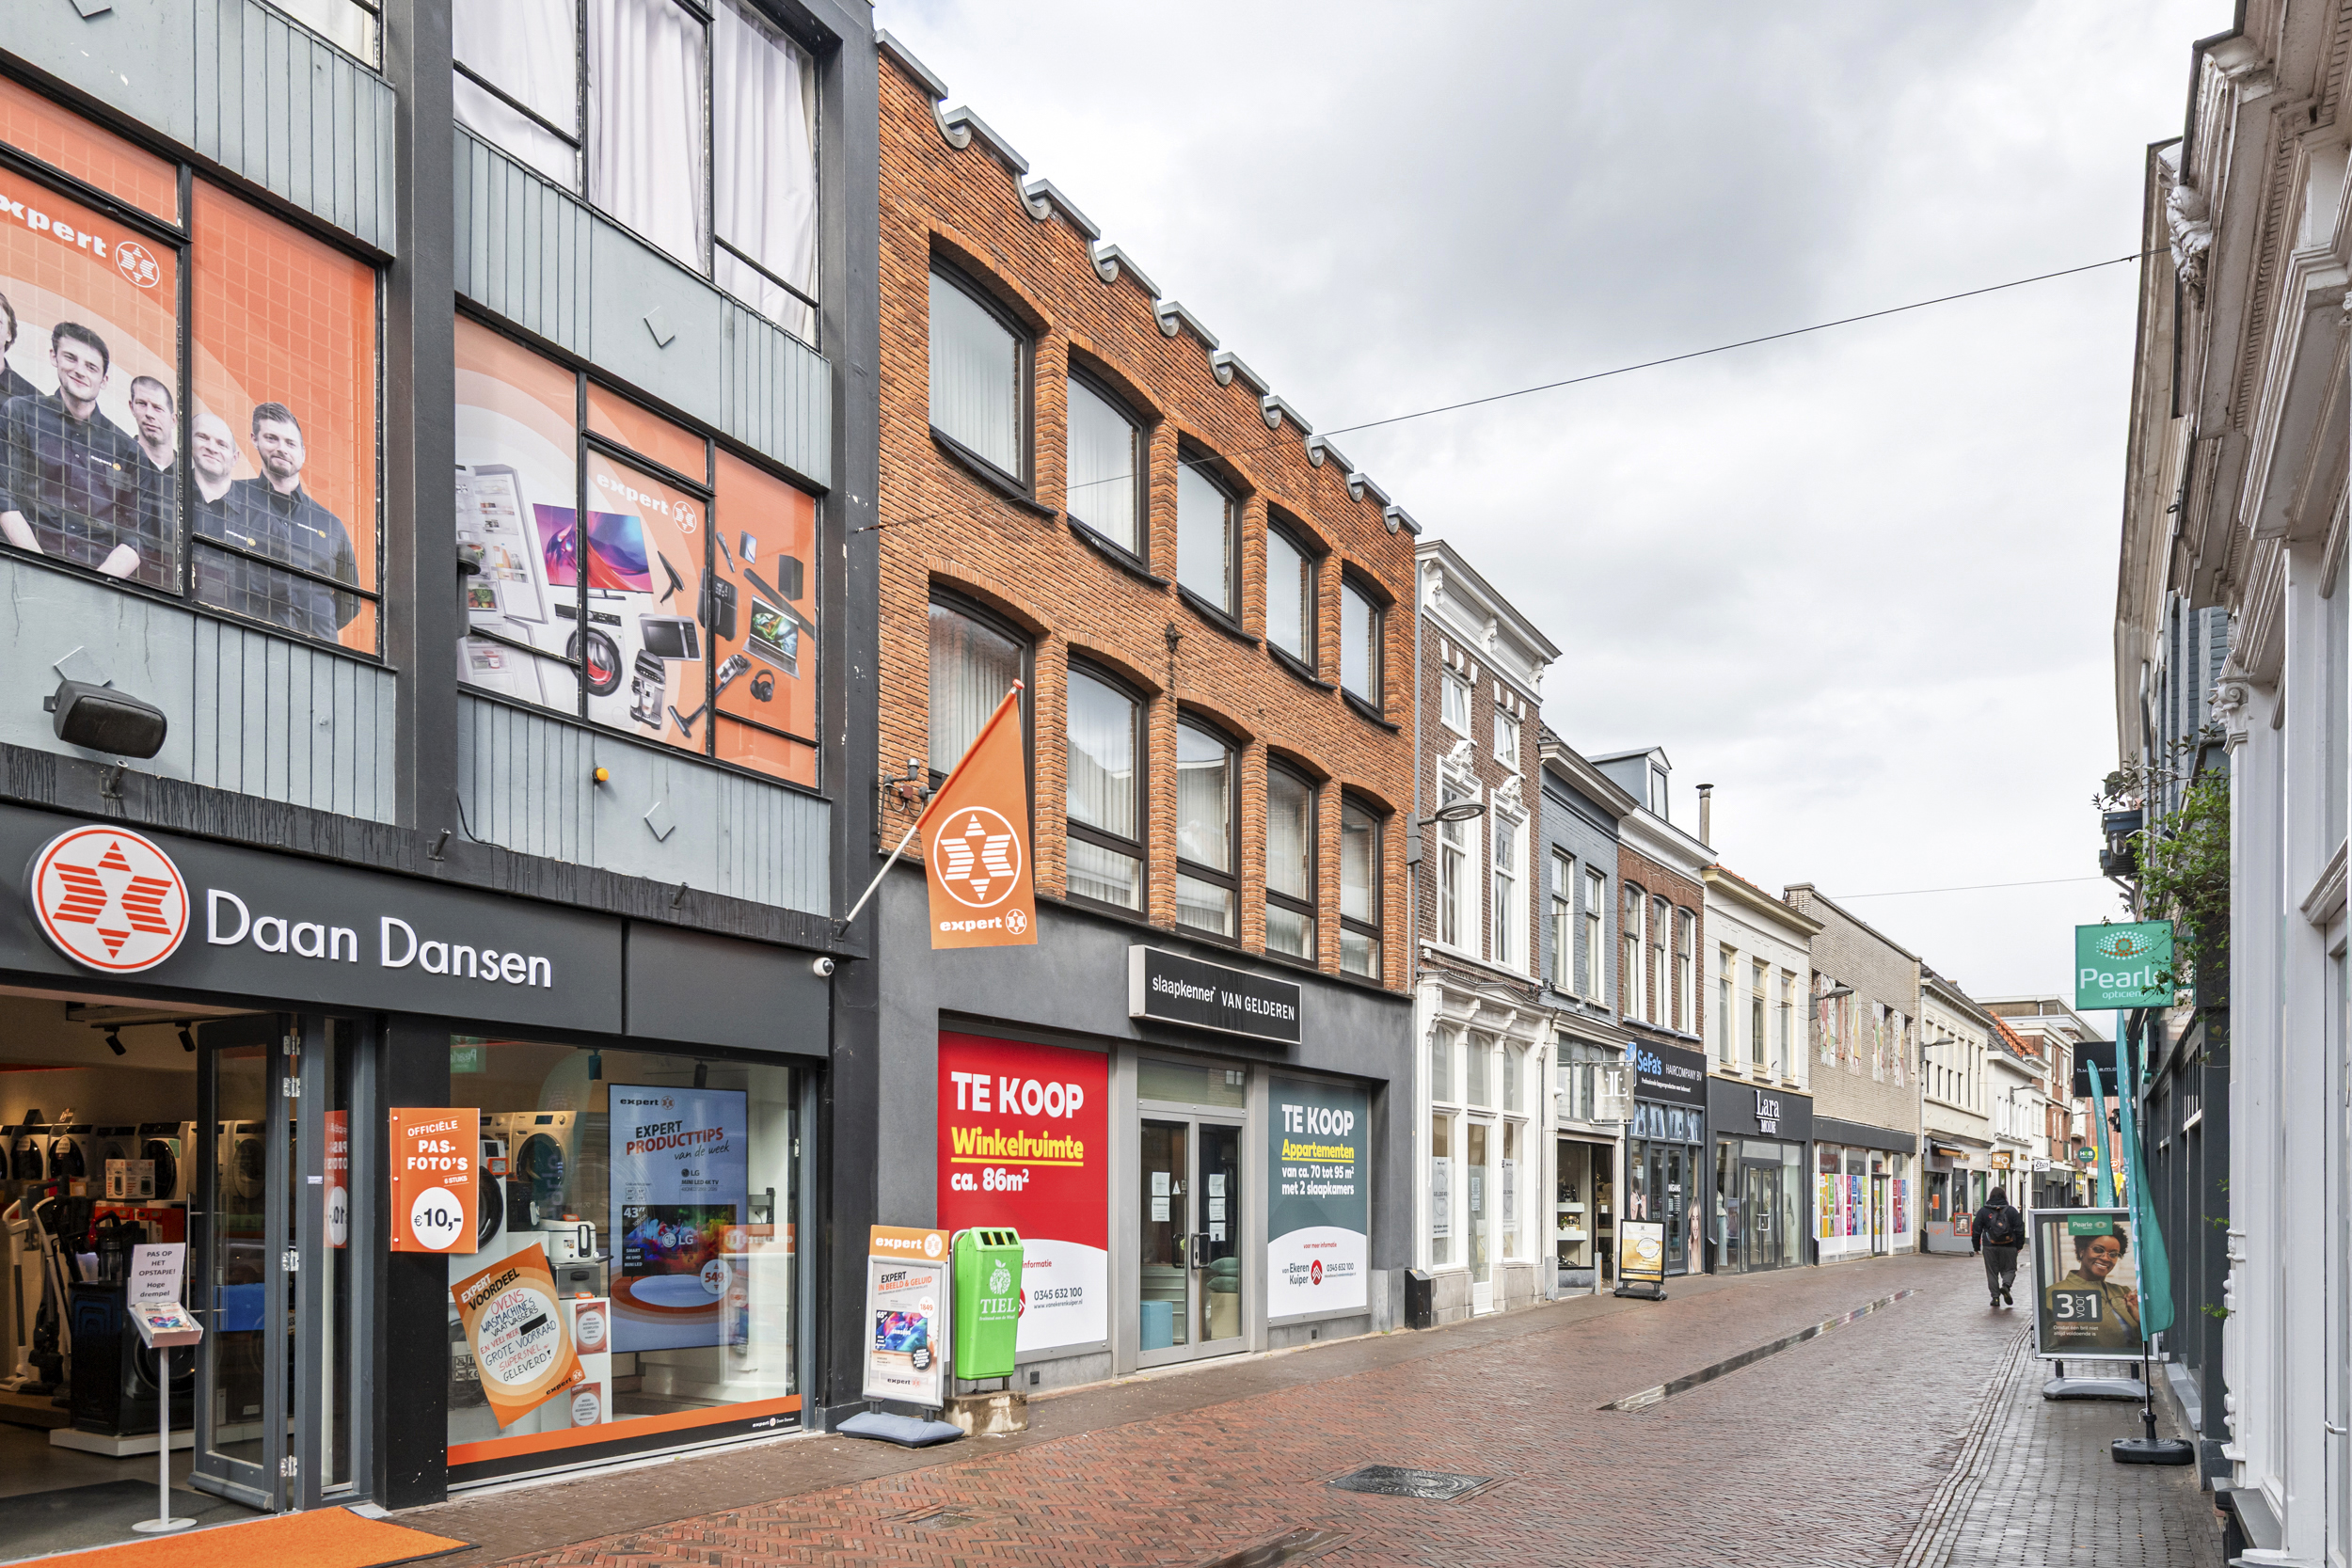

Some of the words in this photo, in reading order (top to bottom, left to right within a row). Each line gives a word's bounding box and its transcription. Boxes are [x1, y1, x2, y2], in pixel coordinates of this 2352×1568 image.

[0, 194, 106, 258] xpert
[596, 473, 669, 516] expert
[940, 916, 1002, 932] expert
[207, 889, 358, 963] Daan
[381, 916, 552, 988] Dansen
[1152, 974, 1215, 1003] slaapkenner
[1221, 990, 1242, 1009] VAN
[1245, 996, 1295, 1021] GELDEREN
[1637, 1049, 1662, 1075] SeFa's
[1665, 1064, 1696, 1080] HAIRCOMPANY
[951, 1071, 991, 1112] TE
[999, 1076, 1084, 1118] KOOP
[1756, 1090, 1780, 1117] Lara
[407, 1120, 458, 1137] OFFICIËLE
[636, 1120, 683, 1138] EXPERT
[1281, 1103, 1303, 1133] TE
[1308, 1106, 1354, 1136] KOOP
[1761, 1119, 1776, 1133] MODE
[418, 1140, 456, 1153] PAS-
[627, 1127, 723, 1155] PRODUCTTIPS
[675, 1152, 691, 1161] van
[694, 1145, 706, 1157] de
[708, 1140, 730, 1154] week
[951, 1126, 1084, 1159] Winkelruimte
[1281, 1138, 1354, 1160] Appartementen
[407, 1157, 469, 1170] FOTO'S
[1281, 1167, 1297, 1178] van
[1298, 1167, 1310, 1178] ca.
[1311, 1165, 1321, 1179] 70
[1322, 1166, 1333, 1179] tot
[1334, 1165, 1343, 1179] 95
[449, 1176, 469, 1184] STUKS
[951, 1172, 977, 1191] ca.
[1281, 1181, 1298, 1195] met
[1299, 1180, 1306, 1195] 2
[1307, 1180, 1354, 1198] slaapkamers
[678, 1235, 694, 1244] LG
[875, 1237, 922, 1250] expert
[1022, 1259, 1052, 1268] informatie
[1289, 1262, 1310, 1273] Ekeren
[1327, 1263, 1337, 1272] 0345
[881, 1271, 907, 1284] EXPERT
[885, 1280, 904, 1291] BEELD
[910, 1275, 932, 1286] GELUID
[1289, 1274, 1309, 1287] Kuiper
[460, 1273, 491, 1304] EXPERT
[469, 1268, 520, 1311] VOORDEEL
[1034, 1290, 1053, 1301] 0345
[1055, 1288, 1068, 1299] 632
[1070, 1287, 1083, 1297] 100
[490, 1290, 525, 1316] OVENS
[979, 1297, 1016, 1314] TIEL
[2057, 1293, 2074, 1319] 3
[2075, 1294, 2085, 1318] voor
[2085, 1293, 2097, 1319] 1
[480, 1296, 535, 1334] WASMACHINES
[490, 1306, 539, 1337] VAATWASSERS
[480, 1345, 491, 1354] EN
[490, 1335, 506, 1350] VEEL
[506, 1328, 520, 1341] MEER
[485, 1344, 515, 1367] GROTE
[517, 1320, 557, 1349] VOORRAAD
[499, 1344, 542, 1372] SUPERSNEL
[546, 1377, 572, 1396] expert
